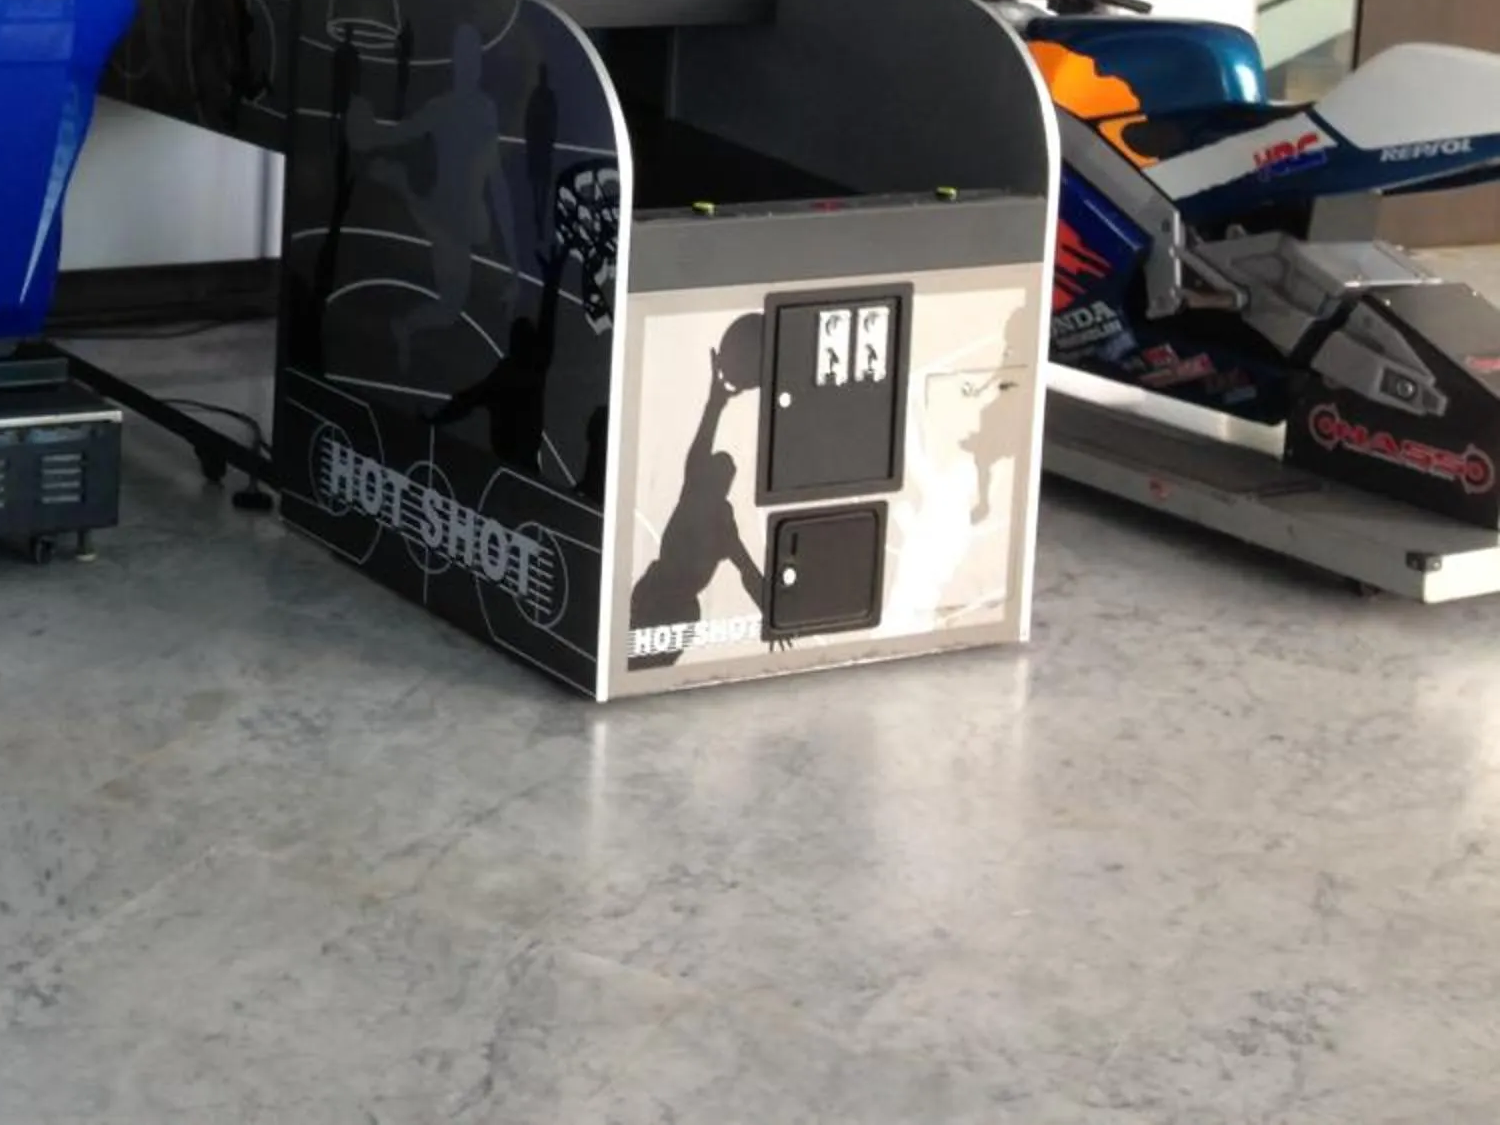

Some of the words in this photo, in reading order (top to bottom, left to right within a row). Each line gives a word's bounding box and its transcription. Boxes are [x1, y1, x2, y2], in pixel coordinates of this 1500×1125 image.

[1053, 300, 1118, 336] NDA
[329, 439, 411, 528] HOT
[419, 487, 541, 597] SHOT
[633, 624, 688, 655] HOT
